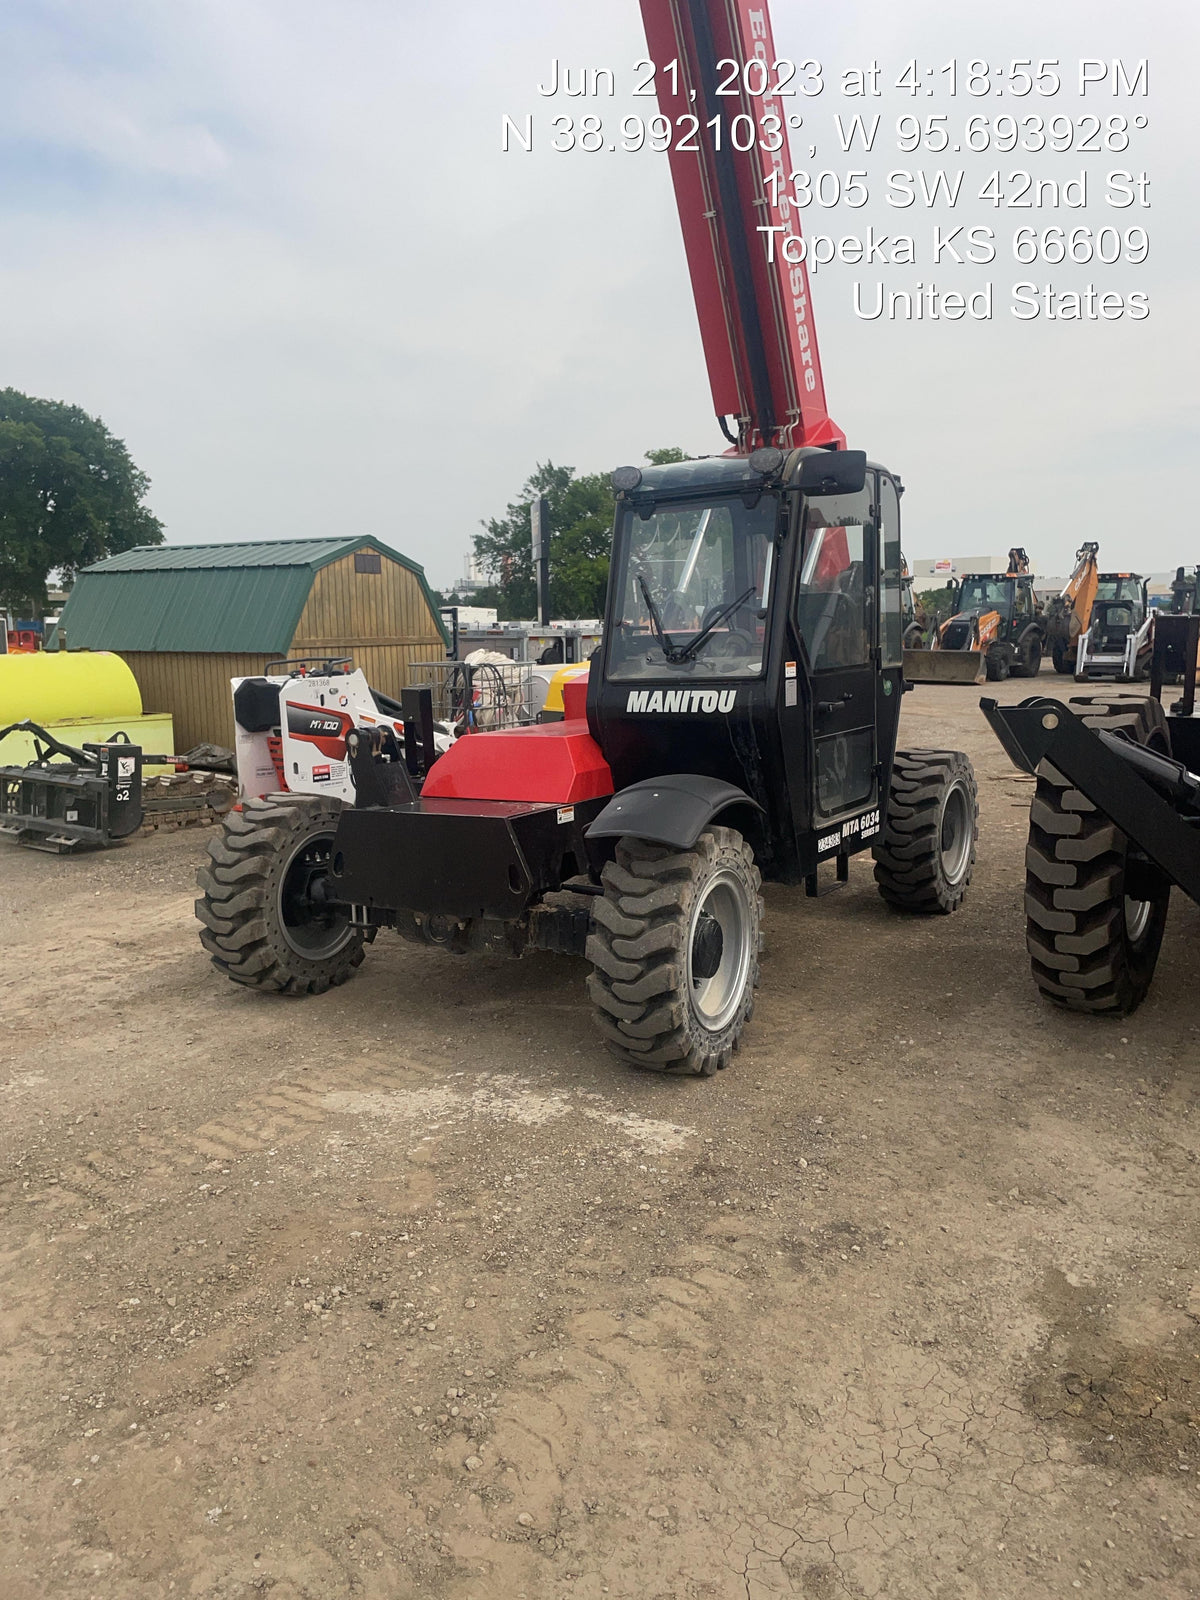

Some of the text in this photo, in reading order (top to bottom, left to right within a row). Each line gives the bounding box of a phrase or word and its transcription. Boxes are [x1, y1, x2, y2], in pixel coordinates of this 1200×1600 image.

[626, 689, 737, 714] MANITOU
[842, 809, 880, 838] MTA 6034
